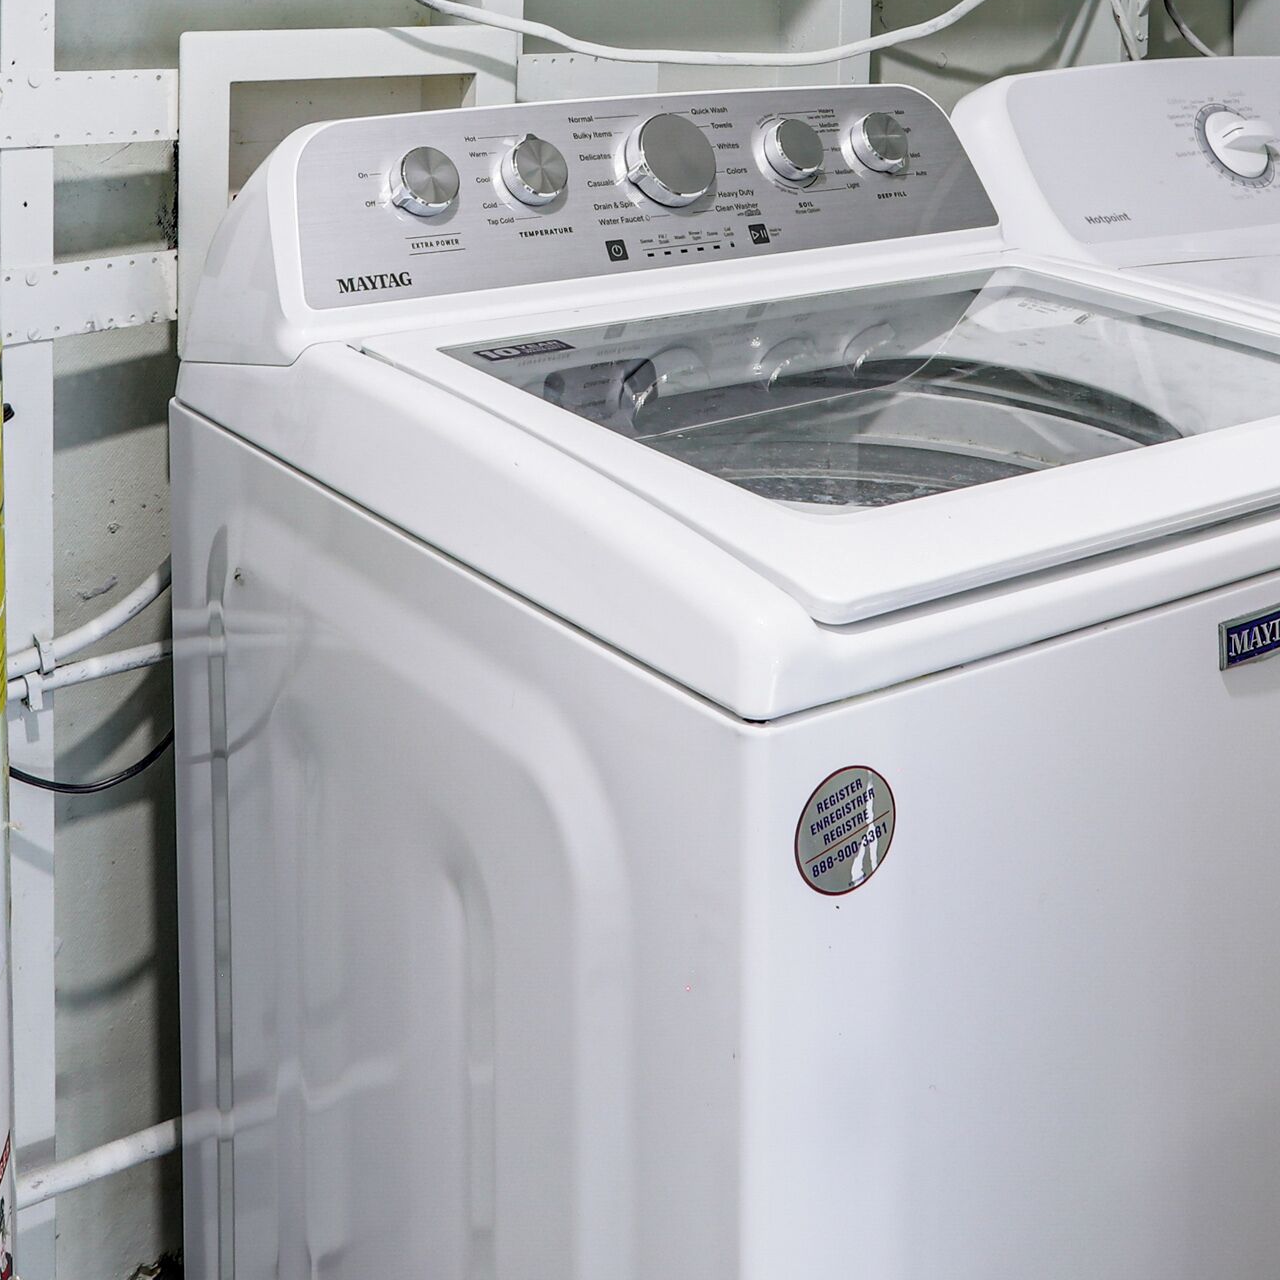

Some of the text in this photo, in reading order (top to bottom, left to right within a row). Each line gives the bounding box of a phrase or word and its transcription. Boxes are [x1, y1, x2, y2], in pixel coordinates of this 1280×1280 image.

[690, 106, 729, 116] Quick Wash
[568, 115, 595, 124] Normal
[710, 121, 733, 130] Towels
[572, 130, 613, 141] Bulky Items
[717, 142, 740, 150] Whites
[469, 150, 488, 158] Warm
[579, 152, 612, 162] Delicates
[726, 167, 748, 175] Colors
[475, 176, 491, 184] Cool
[587, 178, 615, 188] Casuals
[846, 182, 861, 190] Light
[717, 188, 754, 200] Heavy Duty
[365, 200, 377, 208] Off
[482, 201, 498, 210] Cold
[593, 199, 636, 211] Drain & Spin
[715, 204, 734, 213] Clean
[734, 201, 759, 211] Washer
[487, 216, 515, 226] Tap Cold
[598, 214, 644, 226] Water Faucet
[1085, 211, 1132, 226] Hotpoint
[519, 226, 574, 238] TEMPERATURE
[411, 238, 460, 250] EXTRA POWER
[336, 271, 413, 294] MAYTAG
[479, 347, 522, 359] 10
[816, 778, 863, 815] REGISTER
[810, 787, 876, 837] ENREGISTRER
[823, 808, 870, 846] REGISTRE
